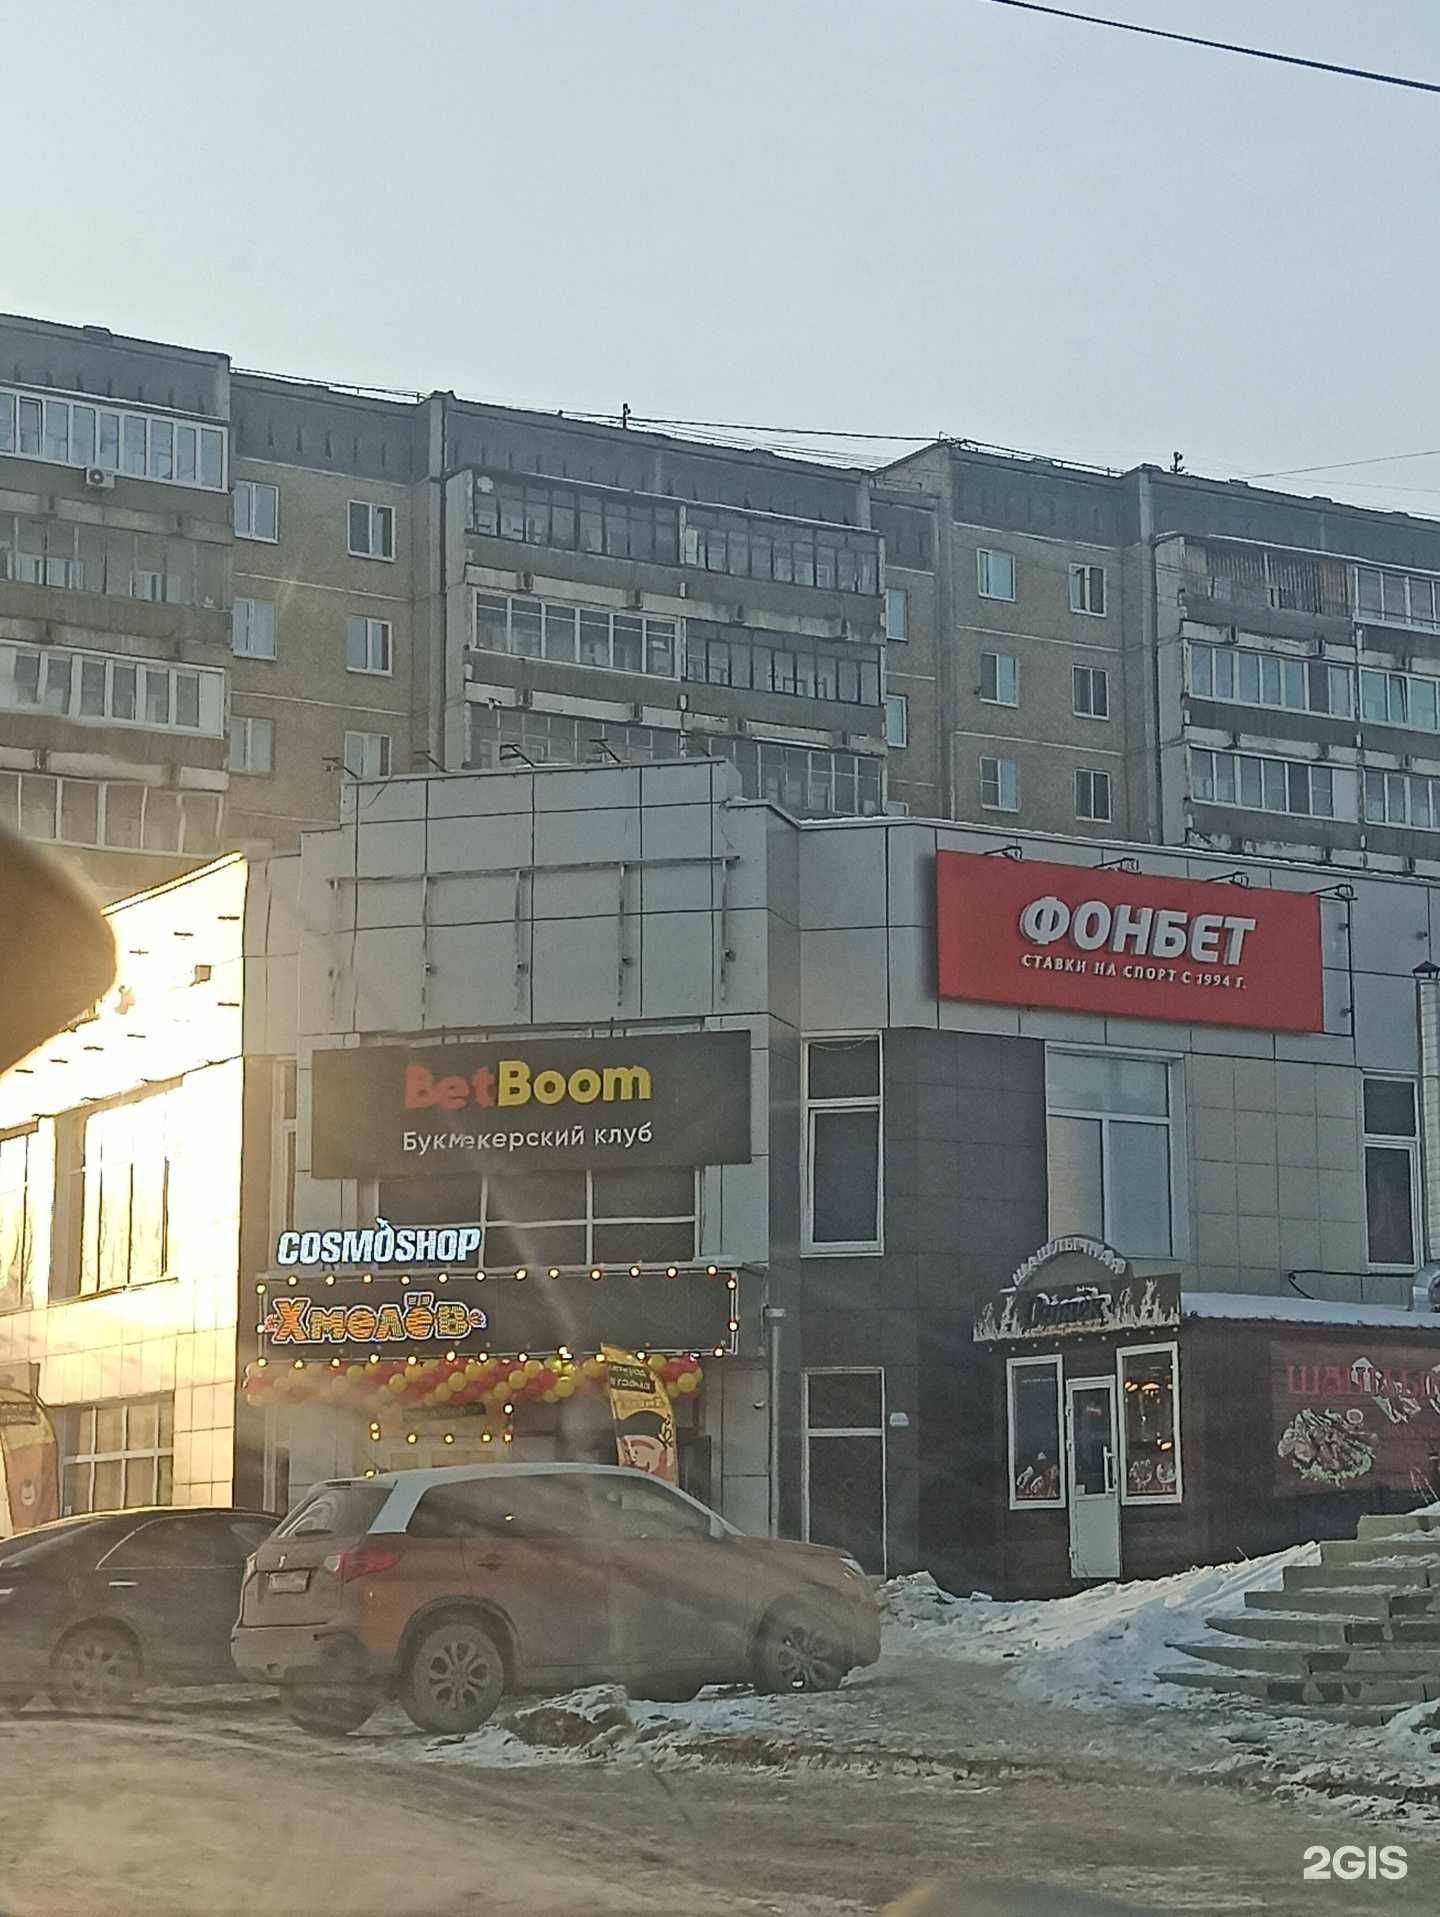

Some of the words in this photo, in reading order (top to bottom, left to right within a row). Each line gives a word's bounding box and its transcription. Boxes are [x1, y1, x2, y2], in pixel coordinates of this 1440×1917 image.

[1020, 896, 1256, 966] ФОНБЕТ
[1022, 953, 1087, 974] СТАВКИ
[1093, 961, 1117, 977] НА
[1123, 964, 1177, 982] СПОРТ
[1196, 973, 1230, 987] 1994
[403, 1060, 652, 1111] BetBoom
[402, 1124, 586, 1156] Букмекерский
[594, 1122, 653, 1148] клуб
[277, 1227, 481, 1265] COSMOSHOP
